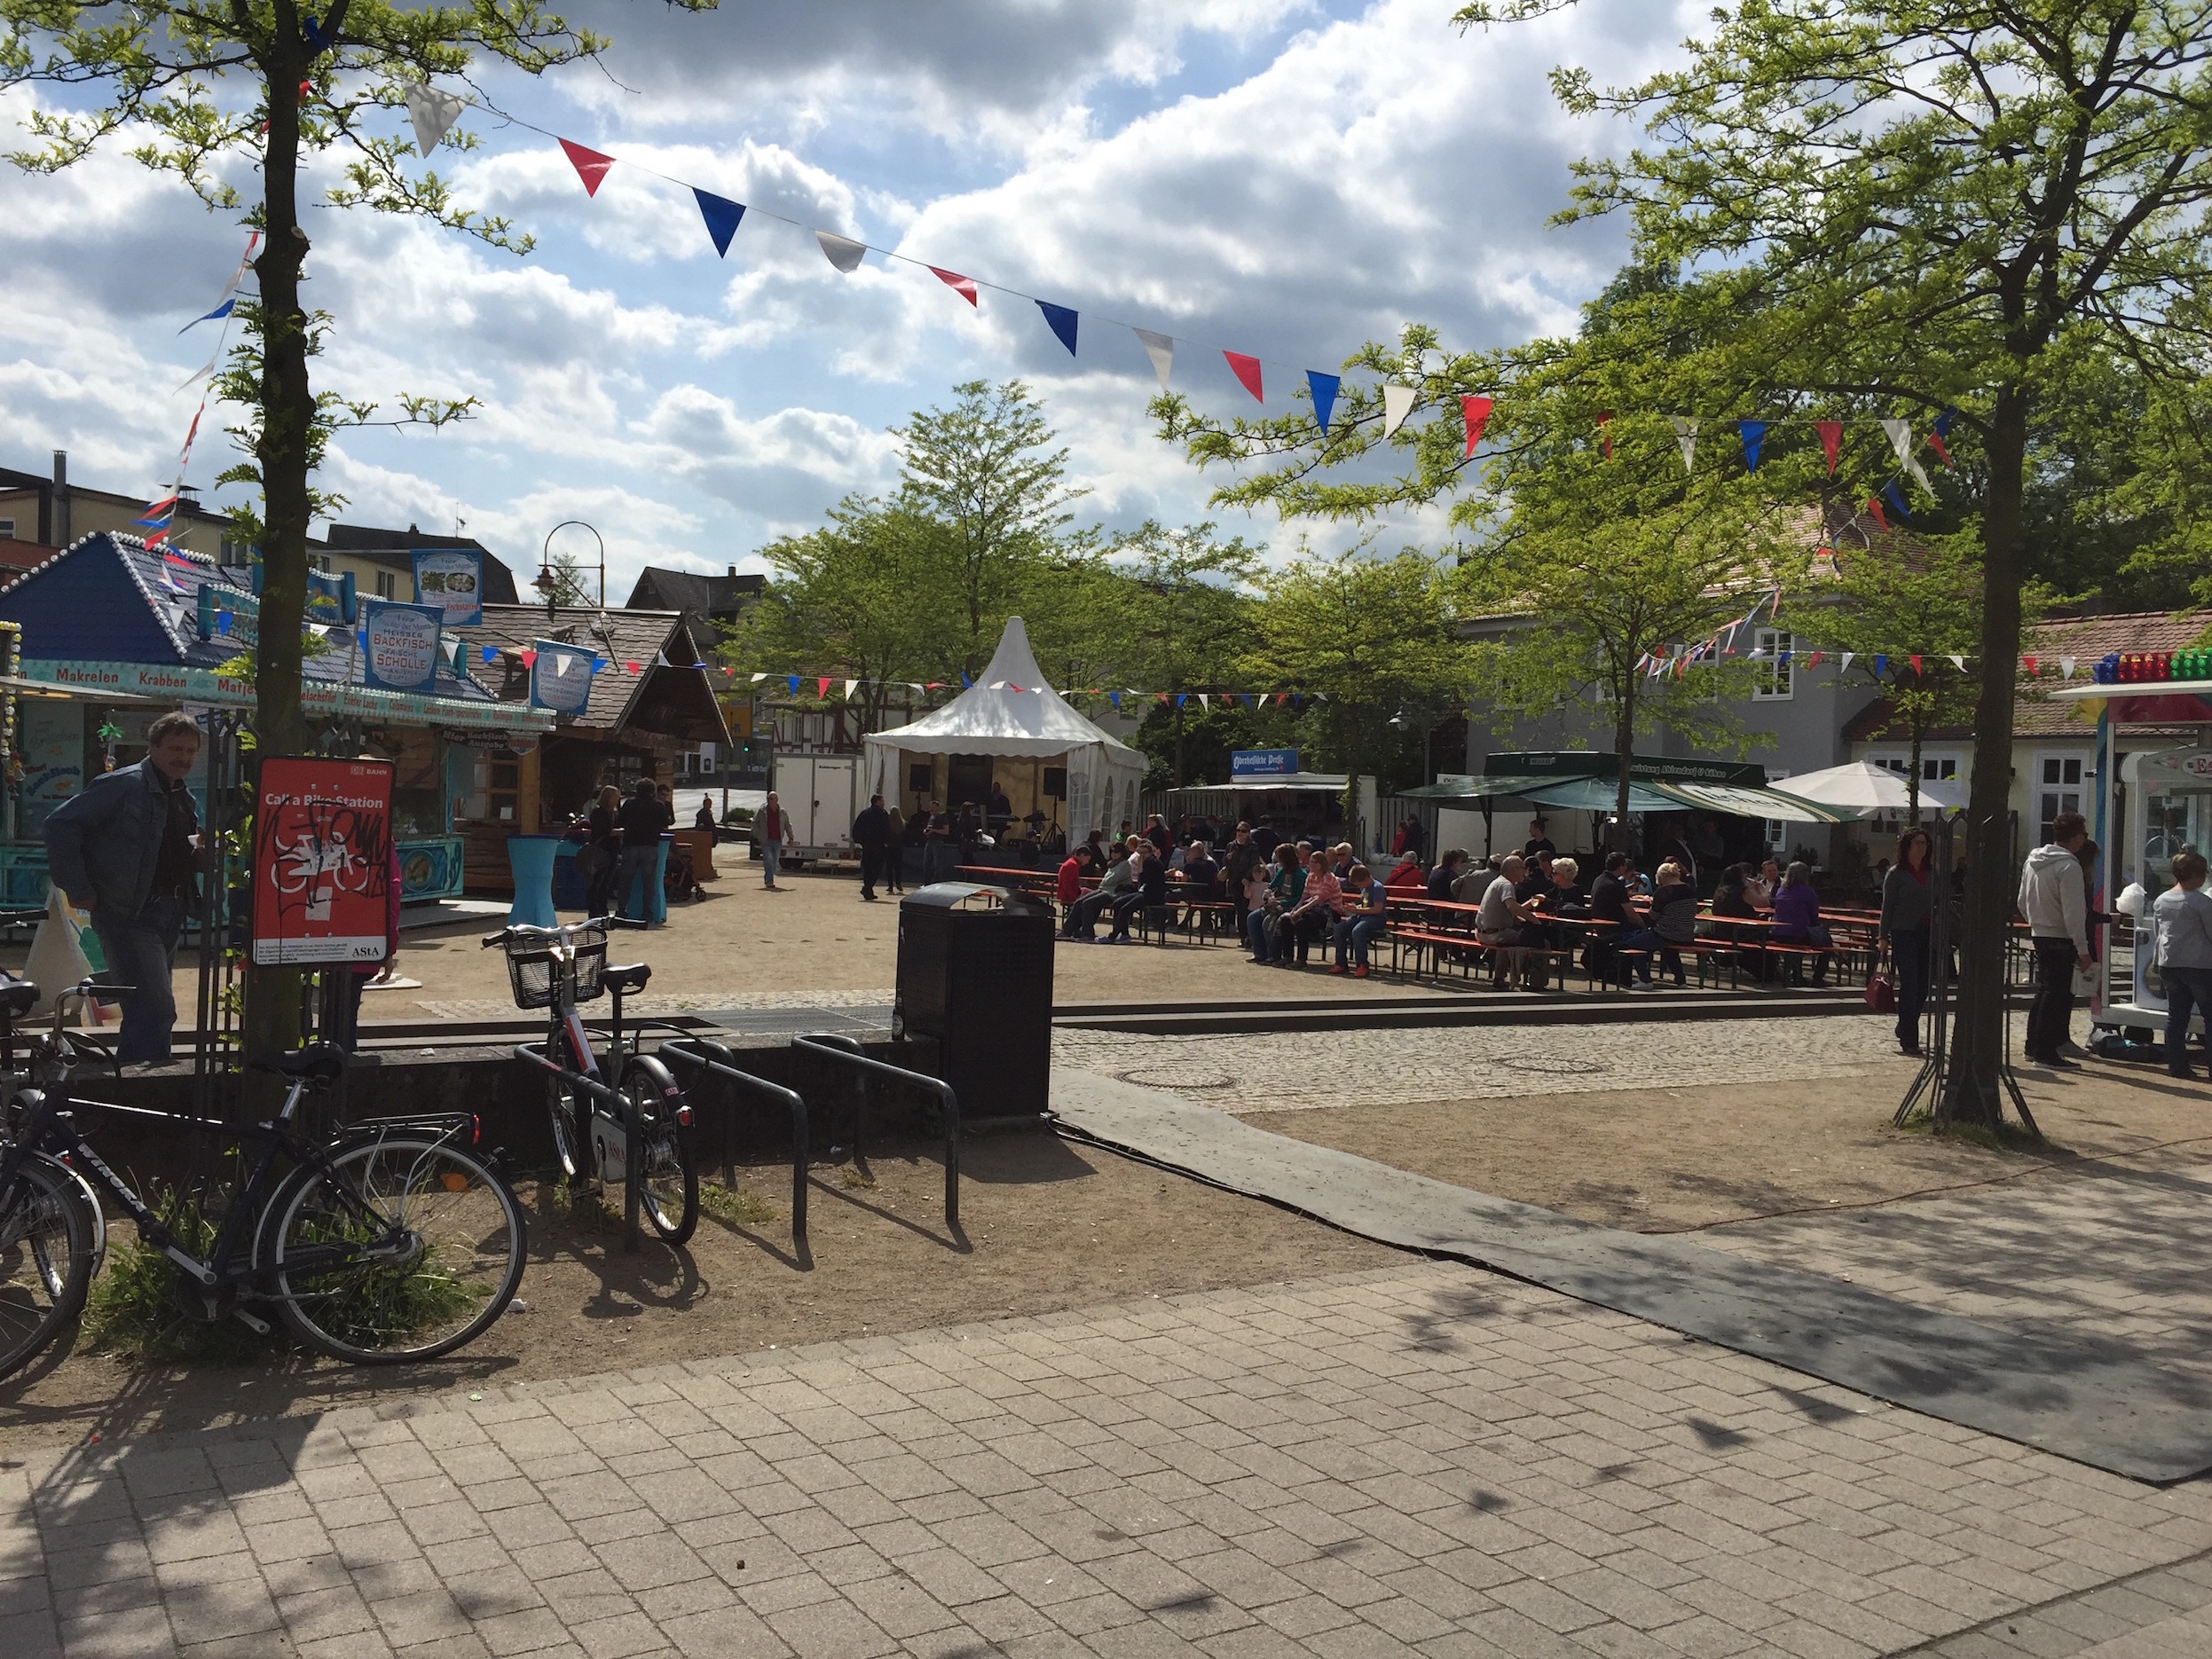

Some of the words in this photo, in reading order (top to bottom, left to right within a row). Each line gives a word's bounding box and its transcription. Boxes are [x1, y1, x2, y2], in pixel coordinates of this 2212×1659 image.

[383, 628, 423, 639] HEISSER
[374, 633, 433, 650] BACKFISCH
[386, 648, 418, 658] FRISCHE
[376, 653, 427, 670] SCHOLLE
[56, 668, 119, 683] Makrelen
[139, 672, 187, 688] Krabben
[300, 688, 336, 704] elachsfilet
[443, 730, 466, 742] Hier
[265, 793, 289, 806] Call
[292, 796, 301, 806] a
[351, 947, 380, 957] AStA
[77, 1142, 148, 1213] WINORA
